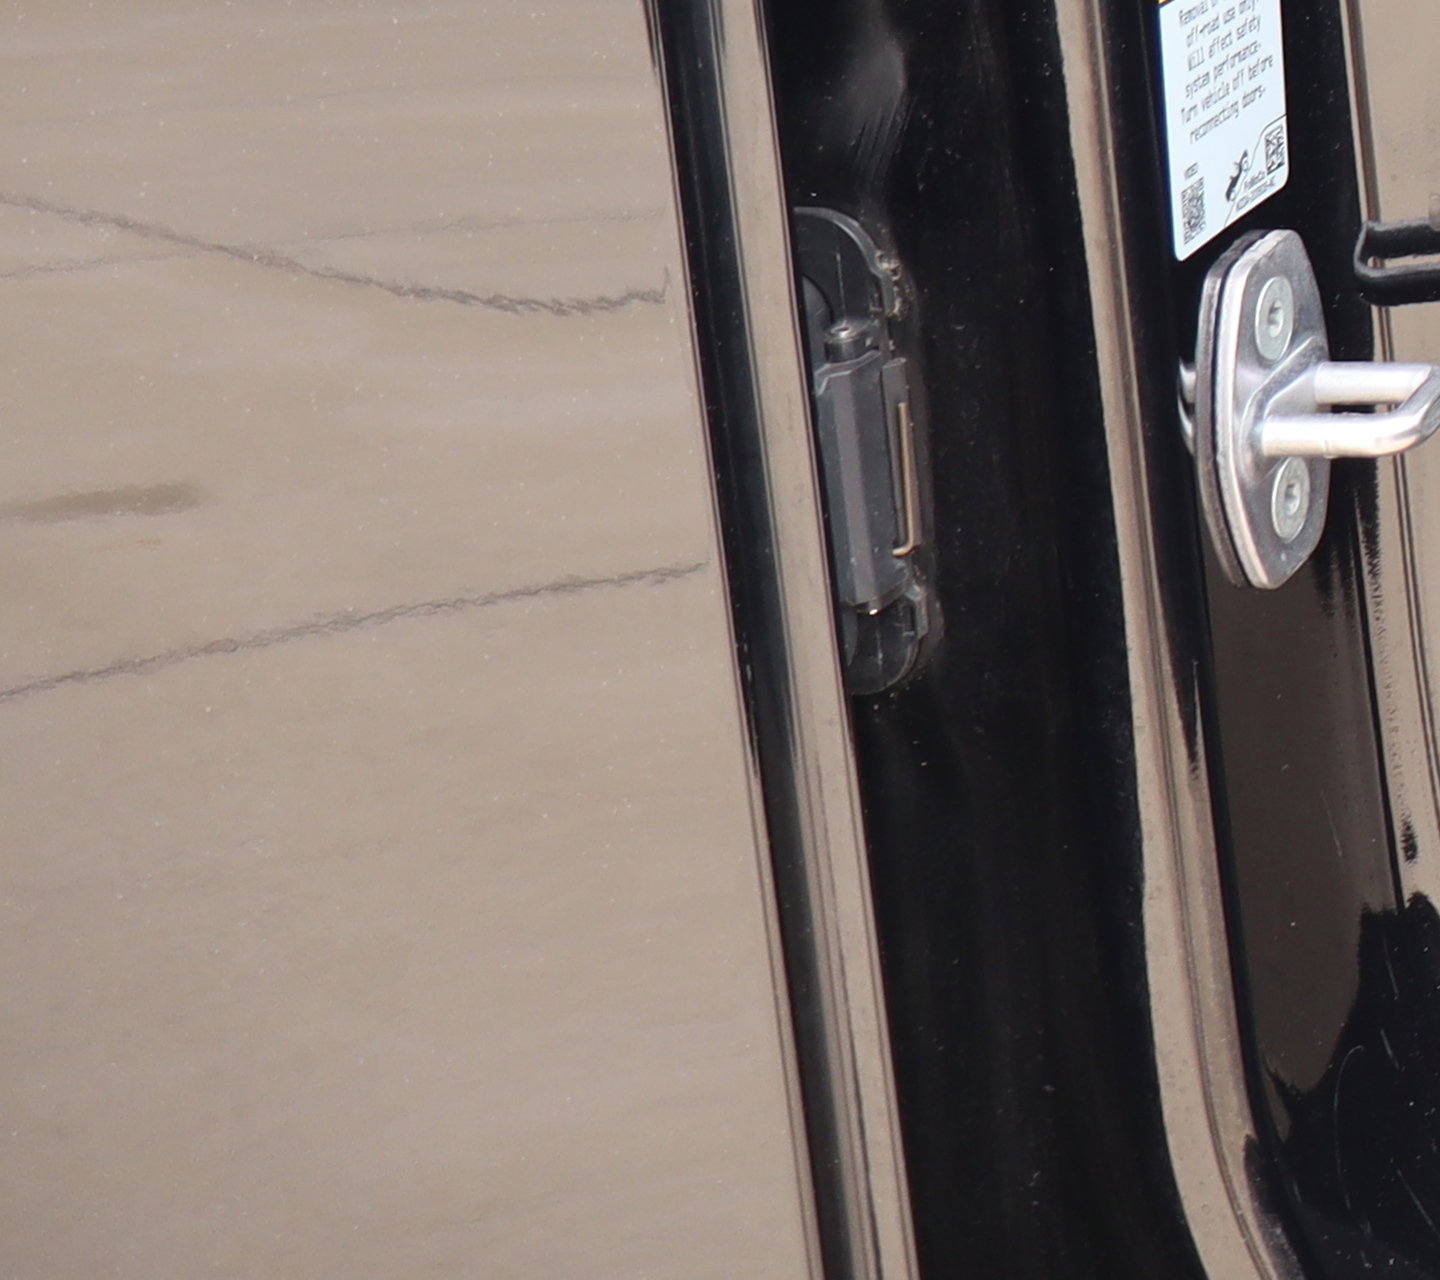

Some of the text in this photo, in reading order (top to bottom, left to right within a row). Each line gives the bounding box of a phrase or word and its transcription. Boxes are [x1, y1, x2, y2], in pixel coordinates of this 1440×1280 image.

[1223, 6, 1235, 23] use
[1187, 14, 1260, 71] Will affect safety
[1181, 55, 1273, 124] Turn vehicle off before
[1190, 100, 1239, 143] reconnecting
